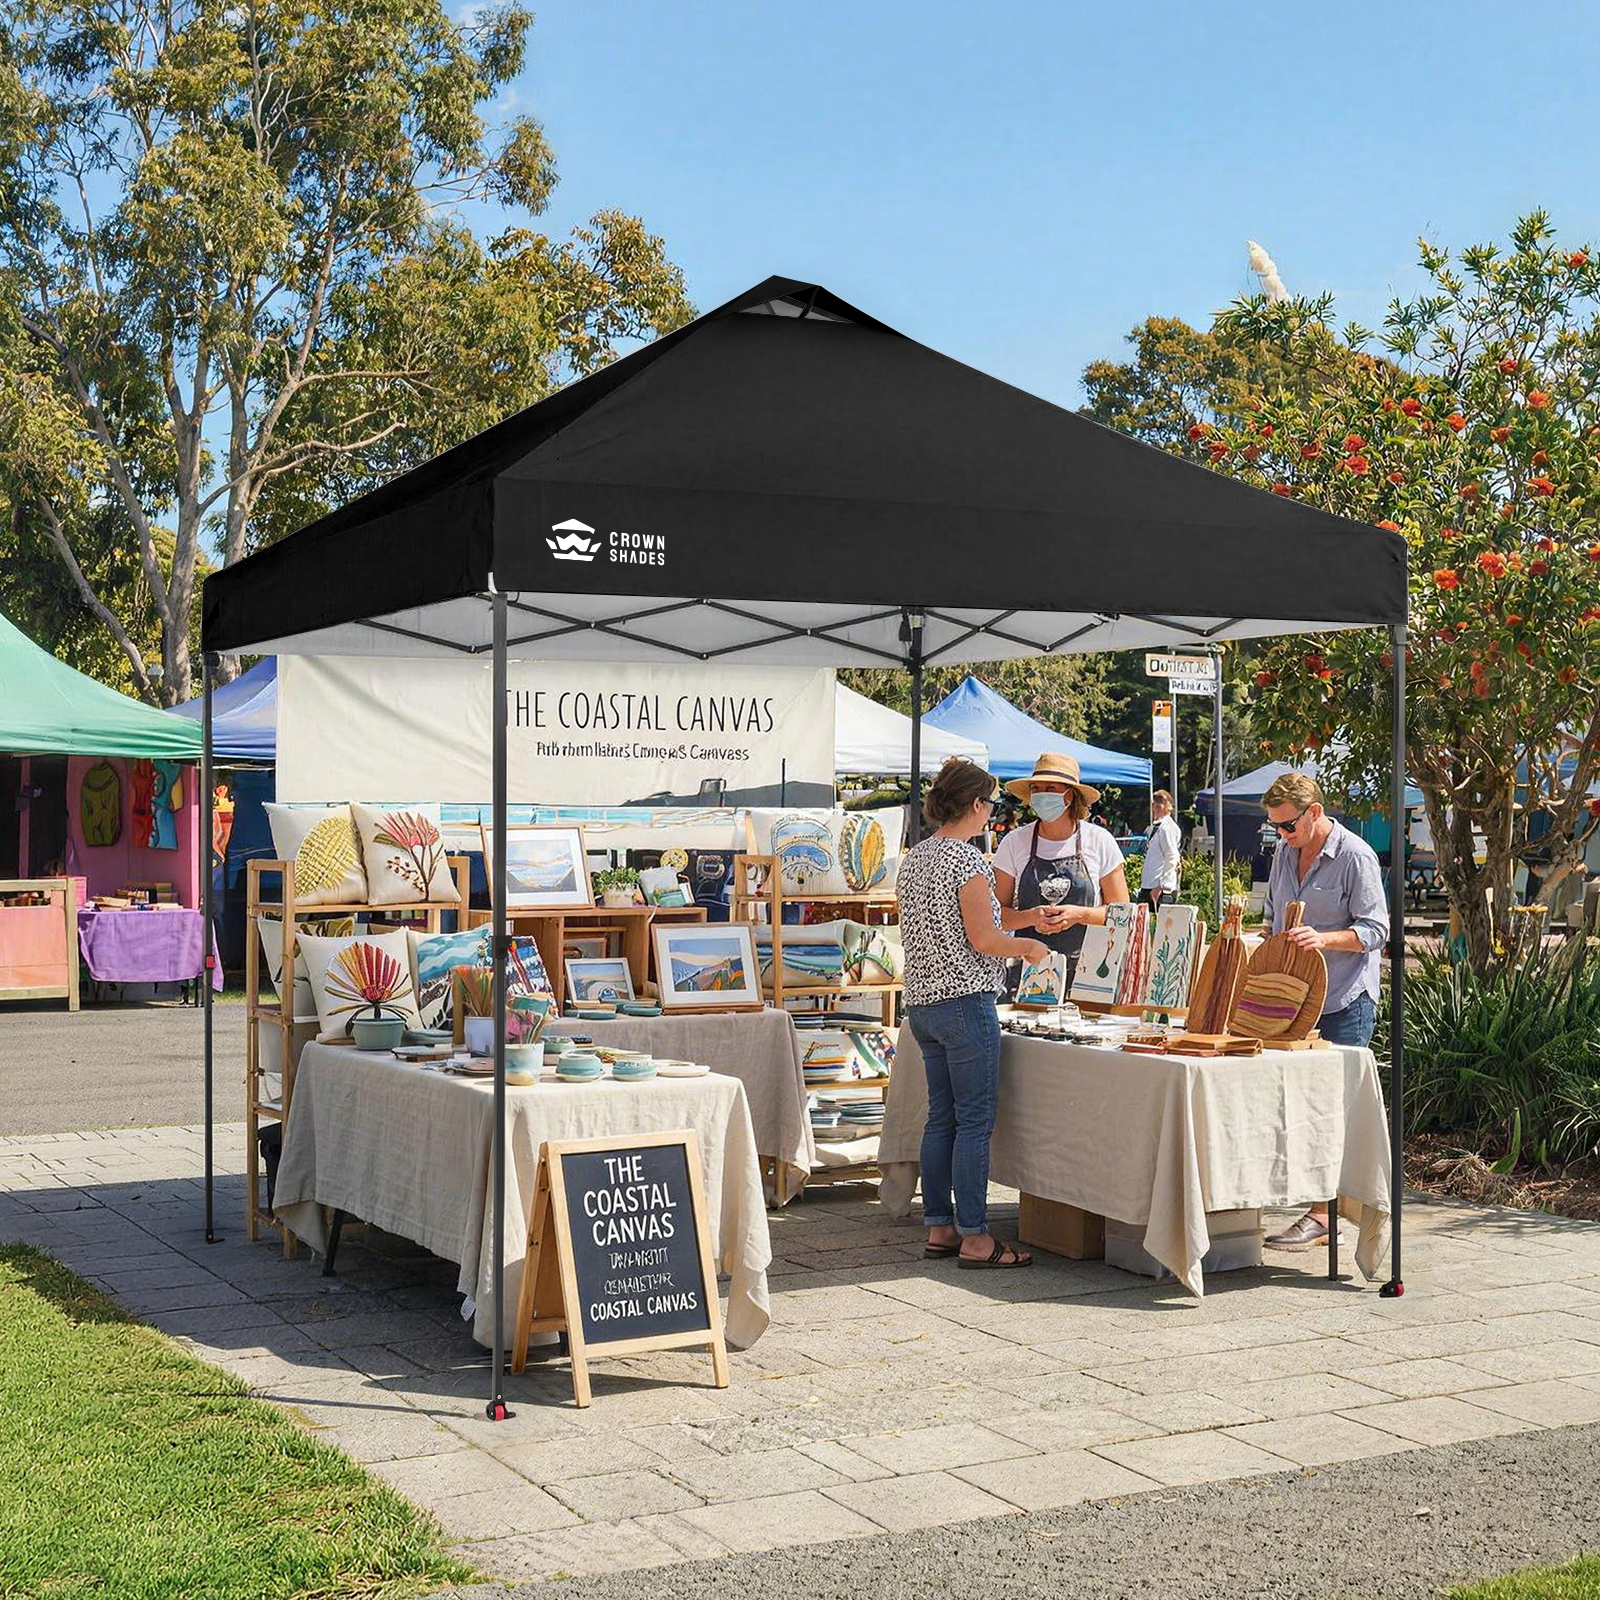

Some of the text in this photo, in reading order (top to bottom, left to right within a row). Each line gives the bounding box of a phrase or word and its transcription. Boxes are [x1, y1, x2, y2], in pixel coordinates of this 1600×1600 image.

[609, 531, 665, 550] CROWN
[609, 549, 665, 566] SHADES
[558, 691, 667, 731] COASTAL
[676, 695, 774, 733] CANVAS
[604, 1155, 645, 1185] THE
[584, 1182, 677, 1218] COASTAL
[592, 1212, 675, 1247] CANVAS
[590, 1291, 698, 1322] COASTAL CANVAS
